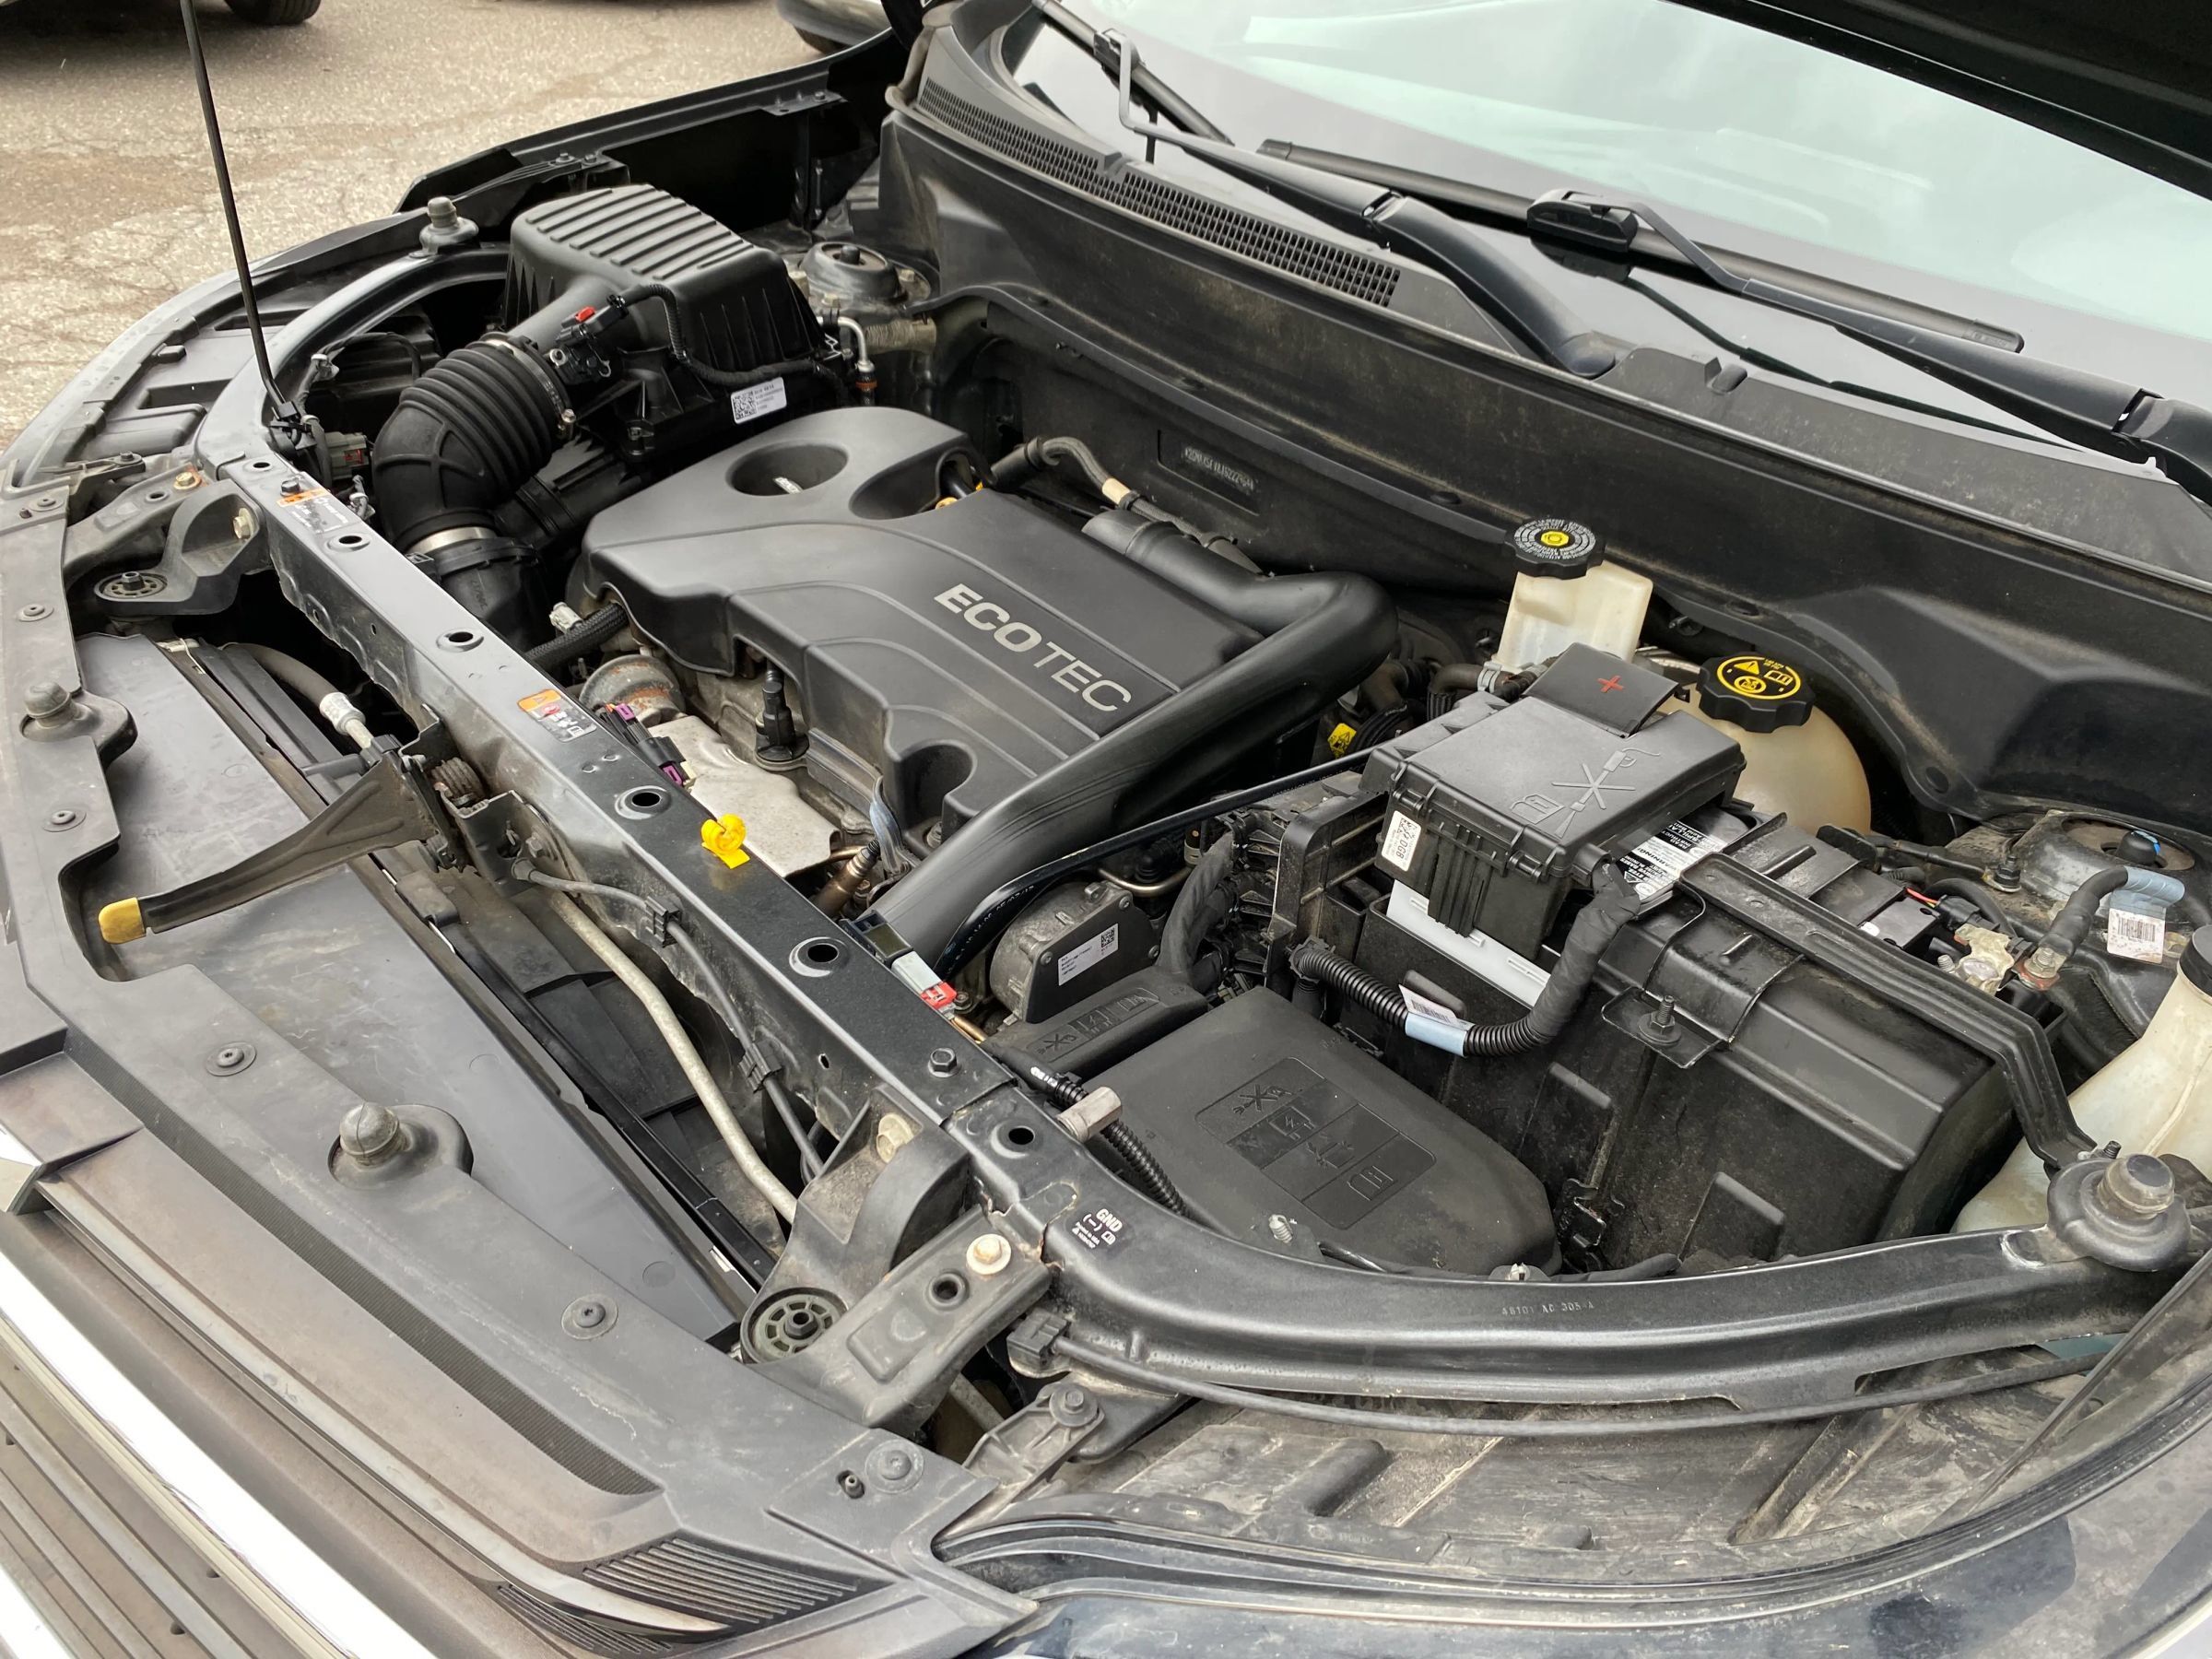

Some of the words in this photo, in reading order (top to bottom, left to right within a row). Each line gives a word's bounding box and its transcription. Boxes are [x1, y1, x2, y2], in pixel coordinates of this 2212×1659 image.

[934, 582, 1132, 712] ECOTEC
[1669, 839, 1688, 849] READ
[1637, 848, 1677, 871] WARNING!
[1096, 1208, 1123, 1232] GND
